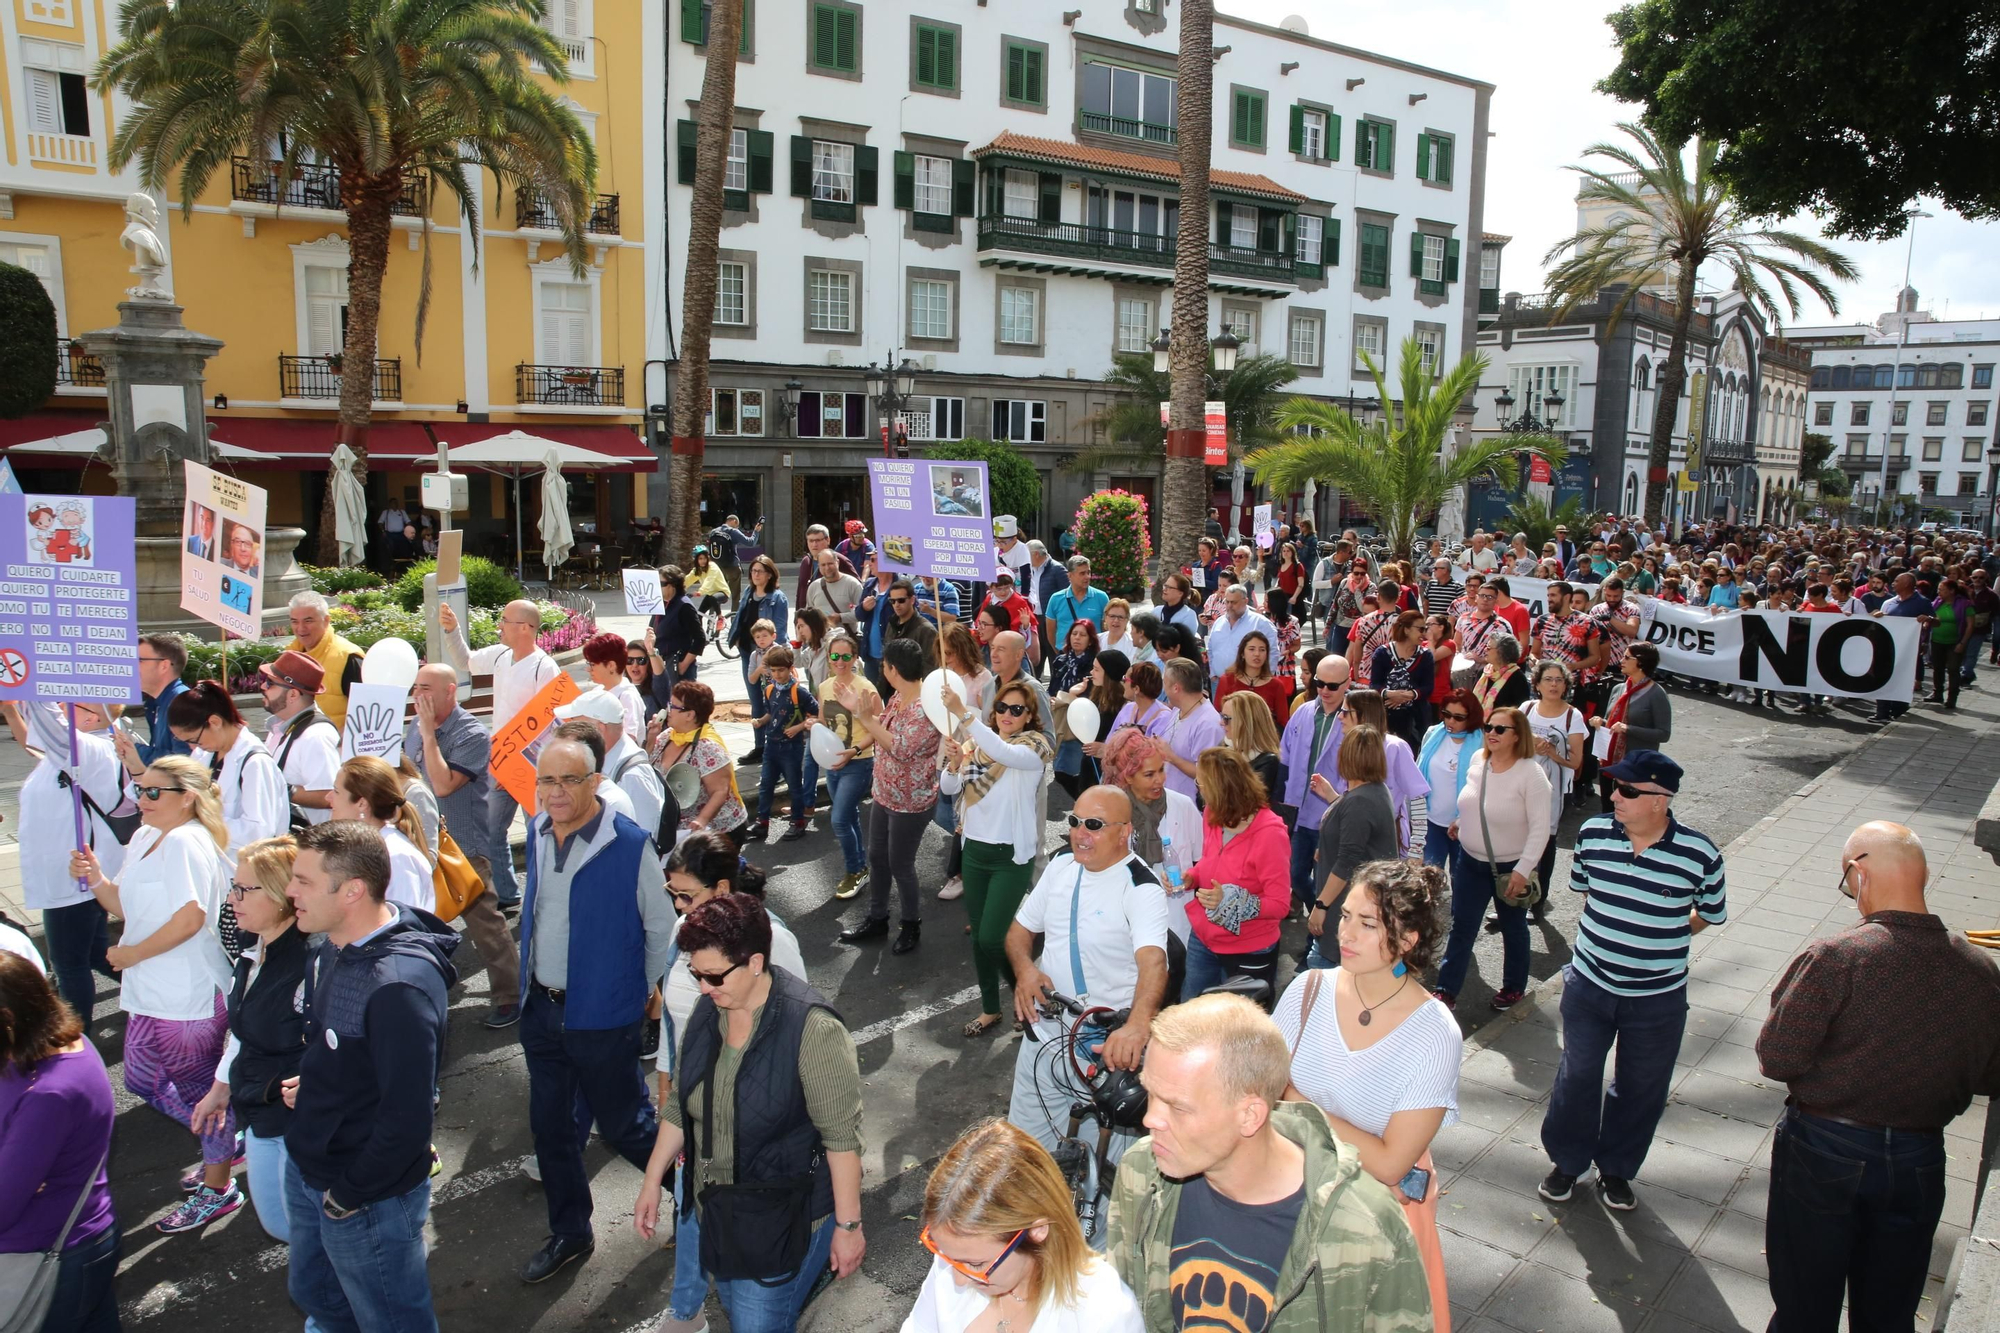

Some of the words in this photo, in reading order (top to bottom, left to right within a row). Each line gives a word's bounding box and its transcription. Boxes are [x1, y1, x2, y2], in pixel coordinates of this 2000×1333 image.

[872, 463, 884, 471] NO
[888, 464, 914, 473] QUIERO
[879, 476, 911, 484] MORIRME
[213, 475, 221, 491] SE
[223, 479, 247, 500] BUSCA
[885, 487, 894, 495] EN
[898, 488, 909, 496] UN
[885, 499, 911, 509] PASILLO
[932, 528, 944, 536] NO
[951, 529, 981, 538] QUIERO
[924, 540, 954, 549] ESPERAR
[958, 543, 985, 552] HORAS
[935, 553, 950, 561] POR
[957, 555, 973, 563] UNA
[8, 566, 52, 578] QUIERO
[61, 570, 117, 583] CUIDARTE
[193, 569, 203, 580] TU
[932, 565, 979, 576] AMBULANCIA
[1, 583, 45, 595] QUIERO
[56, 586, 125, 599] PROTEGERTE
[188, 584, 210, 602] SALUD
[0, 602, 25, 614] OMO
[33, 603, 49, 614] TU
[58, 605, 71, 616] TE
[77, 606, 127, 618] MERECES
[219, 612, 254, 635] NEGOCIO
[1, 623, 23, 634] ERO
[32, 625, 49, 634] NO
[62, 626, 79, 636] ME
[90, 627, 125, 639] DEJAN
[36, 643, 69, 653] FALTA
[77, 644, 134, 657] PERSONAL
[1645, 620, 1716, 656] DICE
[1739, 614, 1896, 694] NO
[38, 662, 71, 673] FALTA
[76, 664, 131, 676] MATERIAL
[38, 684, 78, 695] FALTAN
[84, 686, 127, 698] MEDIOS
[363, 732, 374, 740] NO
[490, 716, 538, 771] ESTO
